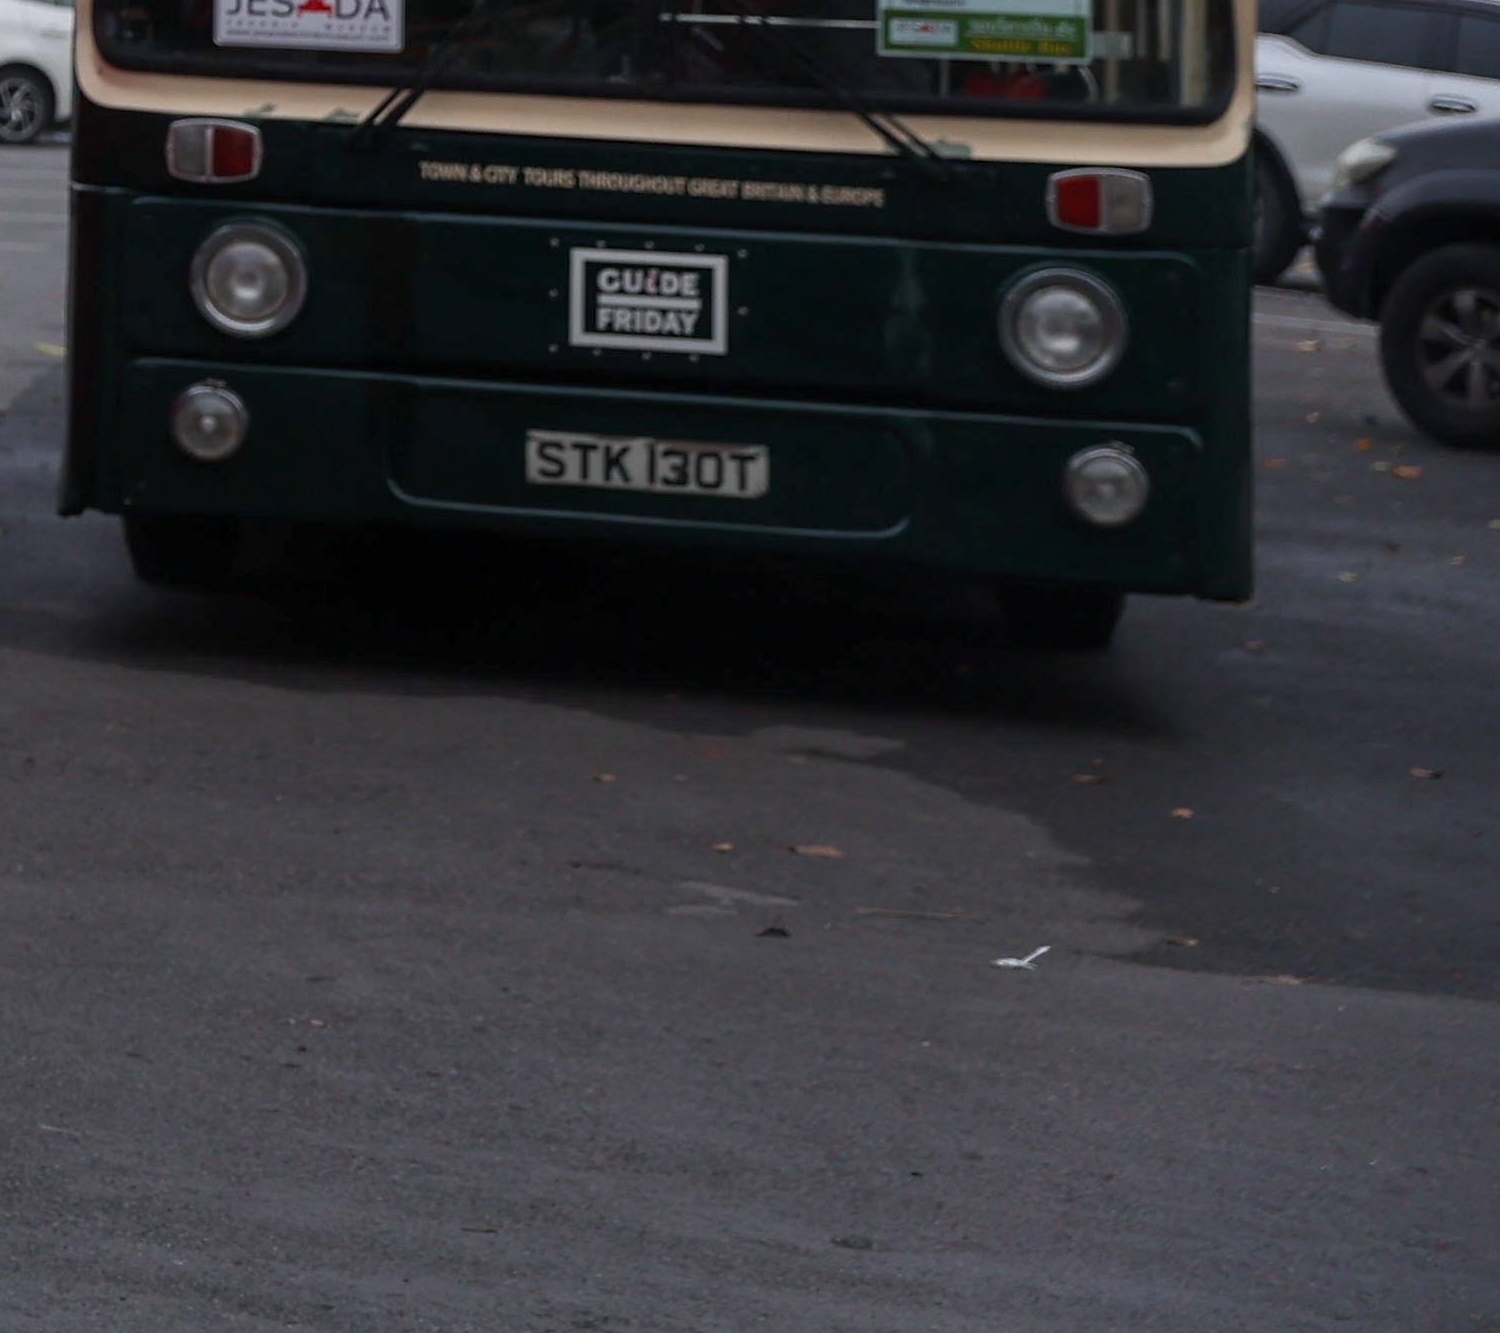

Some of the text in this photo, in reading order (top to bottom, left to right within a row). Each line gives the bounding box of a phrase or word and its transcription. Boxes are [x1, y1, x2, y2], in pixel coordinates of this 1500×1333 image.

[418, 160, 467, 182] TOWN
[483, 163, 518, 185] CITY
[522, 165, 576, 189] TOURS
[577, 168, 686, 197] THROUGHOUT
[687, 176, 740, 199] GREAT
[820, 184, 886, 208] EUROPE
[596, 307, 700, 335] FRIDAY
[537, 441, 631, 483] STK
